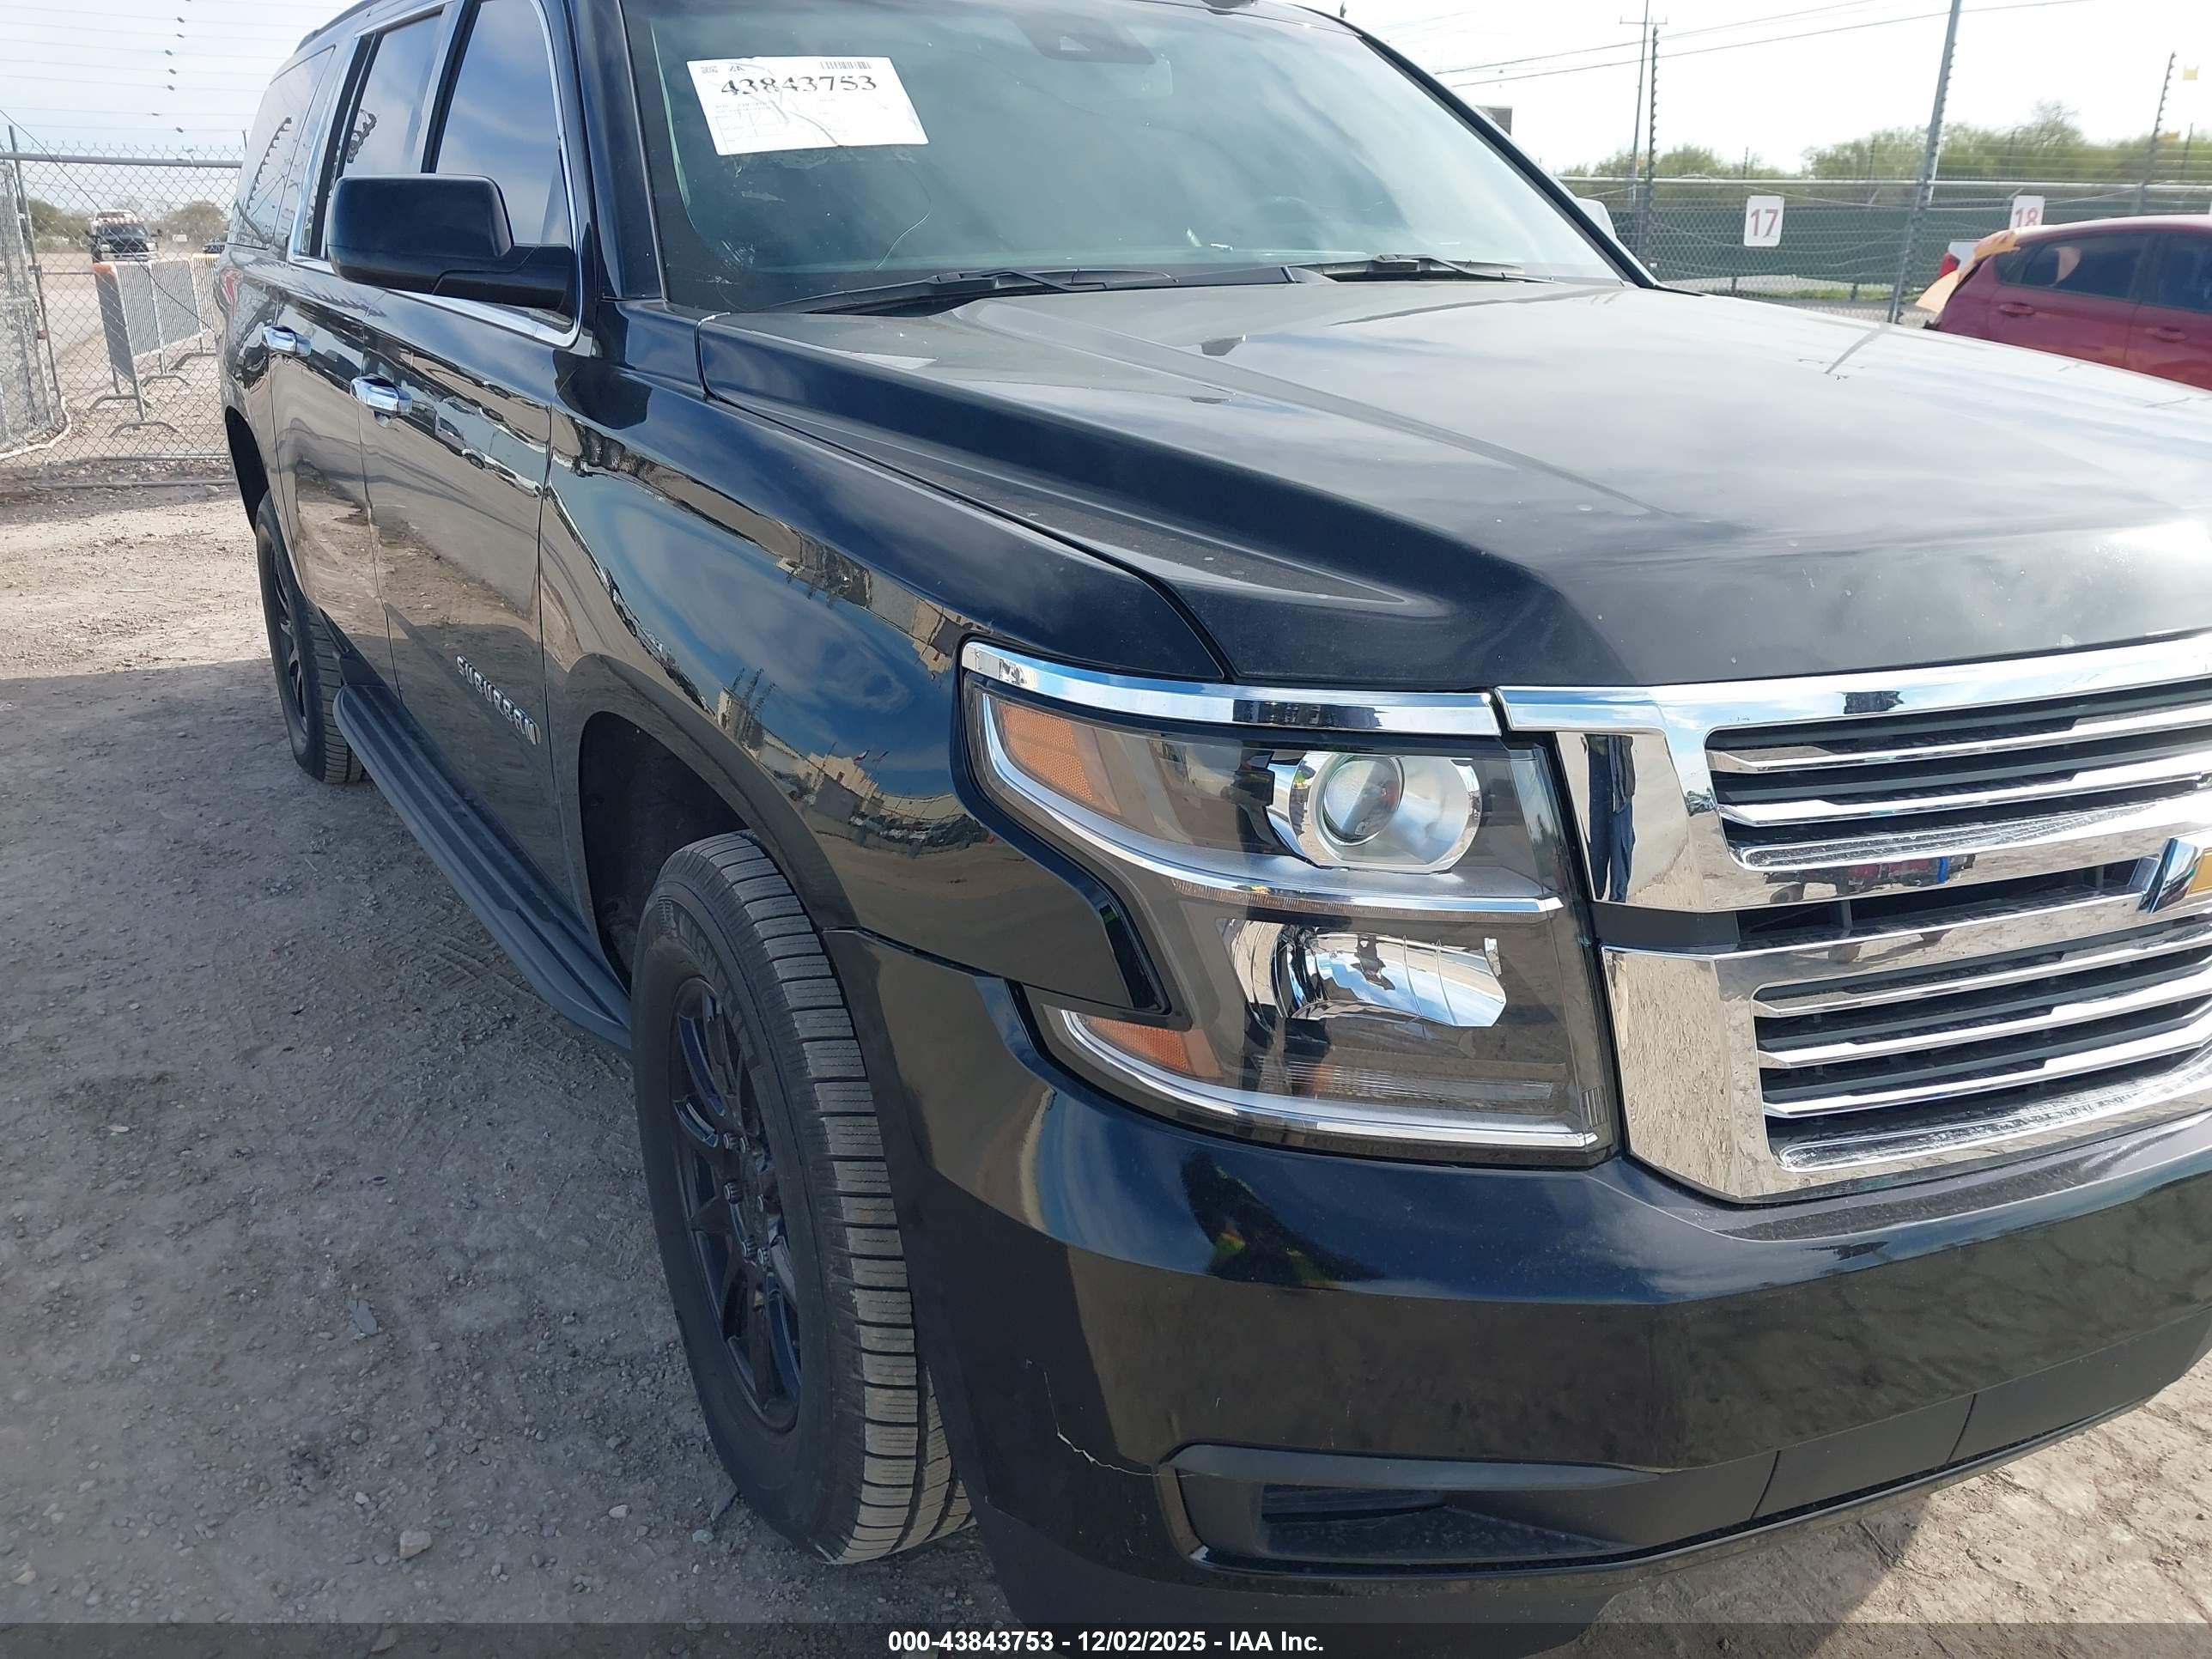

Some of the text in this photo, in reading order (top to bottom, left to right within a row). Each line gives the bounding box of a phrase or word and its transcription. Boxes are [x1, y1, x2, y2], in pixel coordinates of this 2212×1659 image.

[721, 76, 877, 95] 43843753
[1751, 209, 1778, 238] 17
[2015, 207, 2039, 228] 18
[456, 655, 538, 745] SUBURBAN
